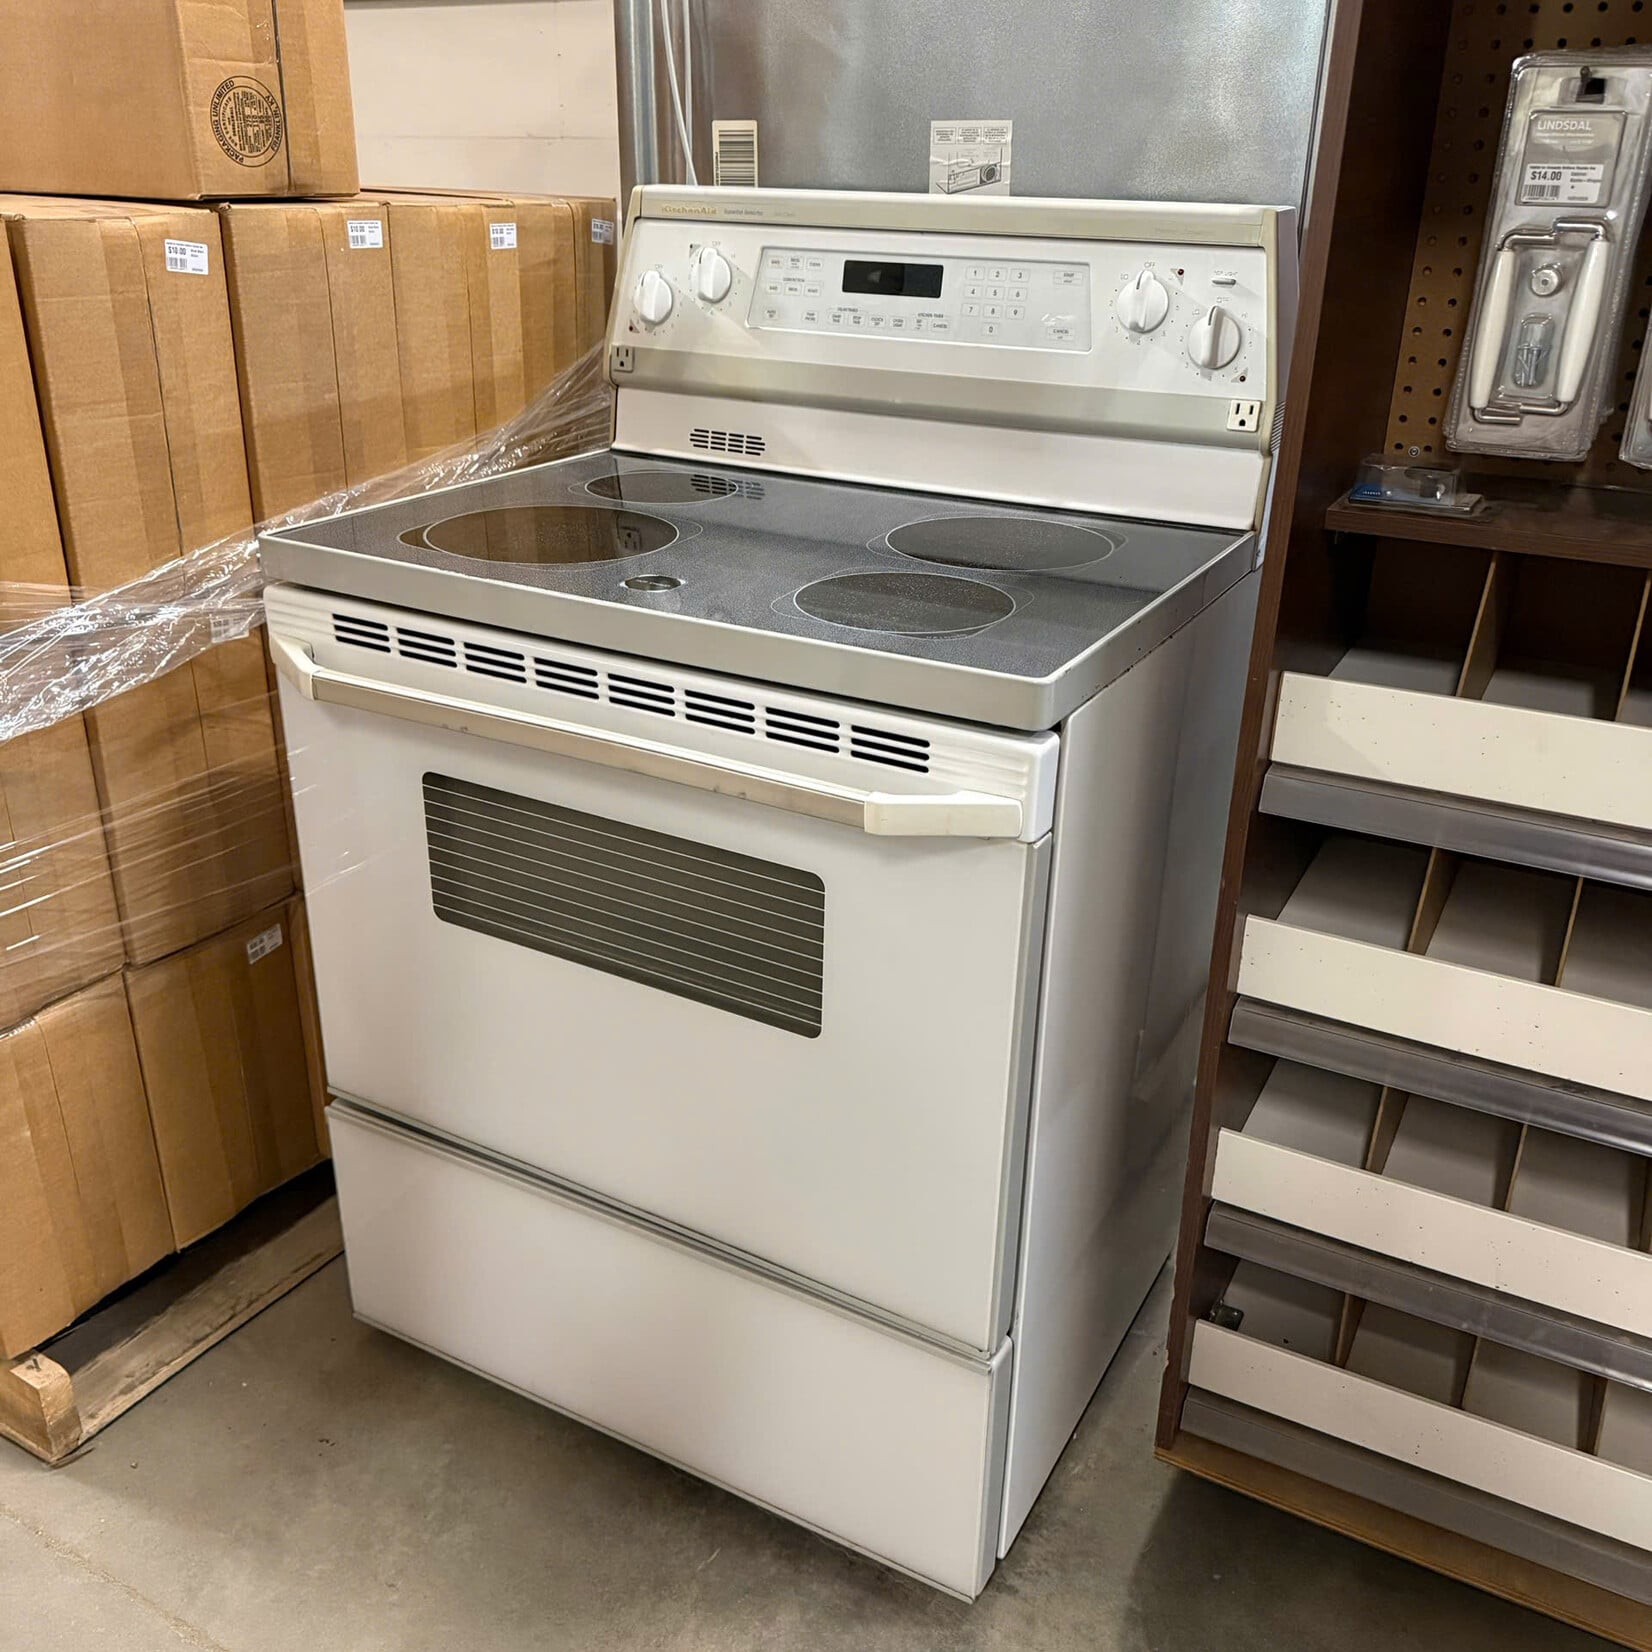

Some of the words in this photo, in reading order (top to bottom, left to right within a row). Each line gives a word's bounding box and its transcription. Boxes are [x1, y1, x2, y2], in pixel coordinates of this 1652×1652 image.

[212, 80, 235, 117] UNLIMITED
[265, 95, 277, 106] KY
[1537, 120, 1592, 130] LINDSDAL
[213, 120, 244, 163] PACKAGING
[1530, 171, 1562, 181] $14.00
